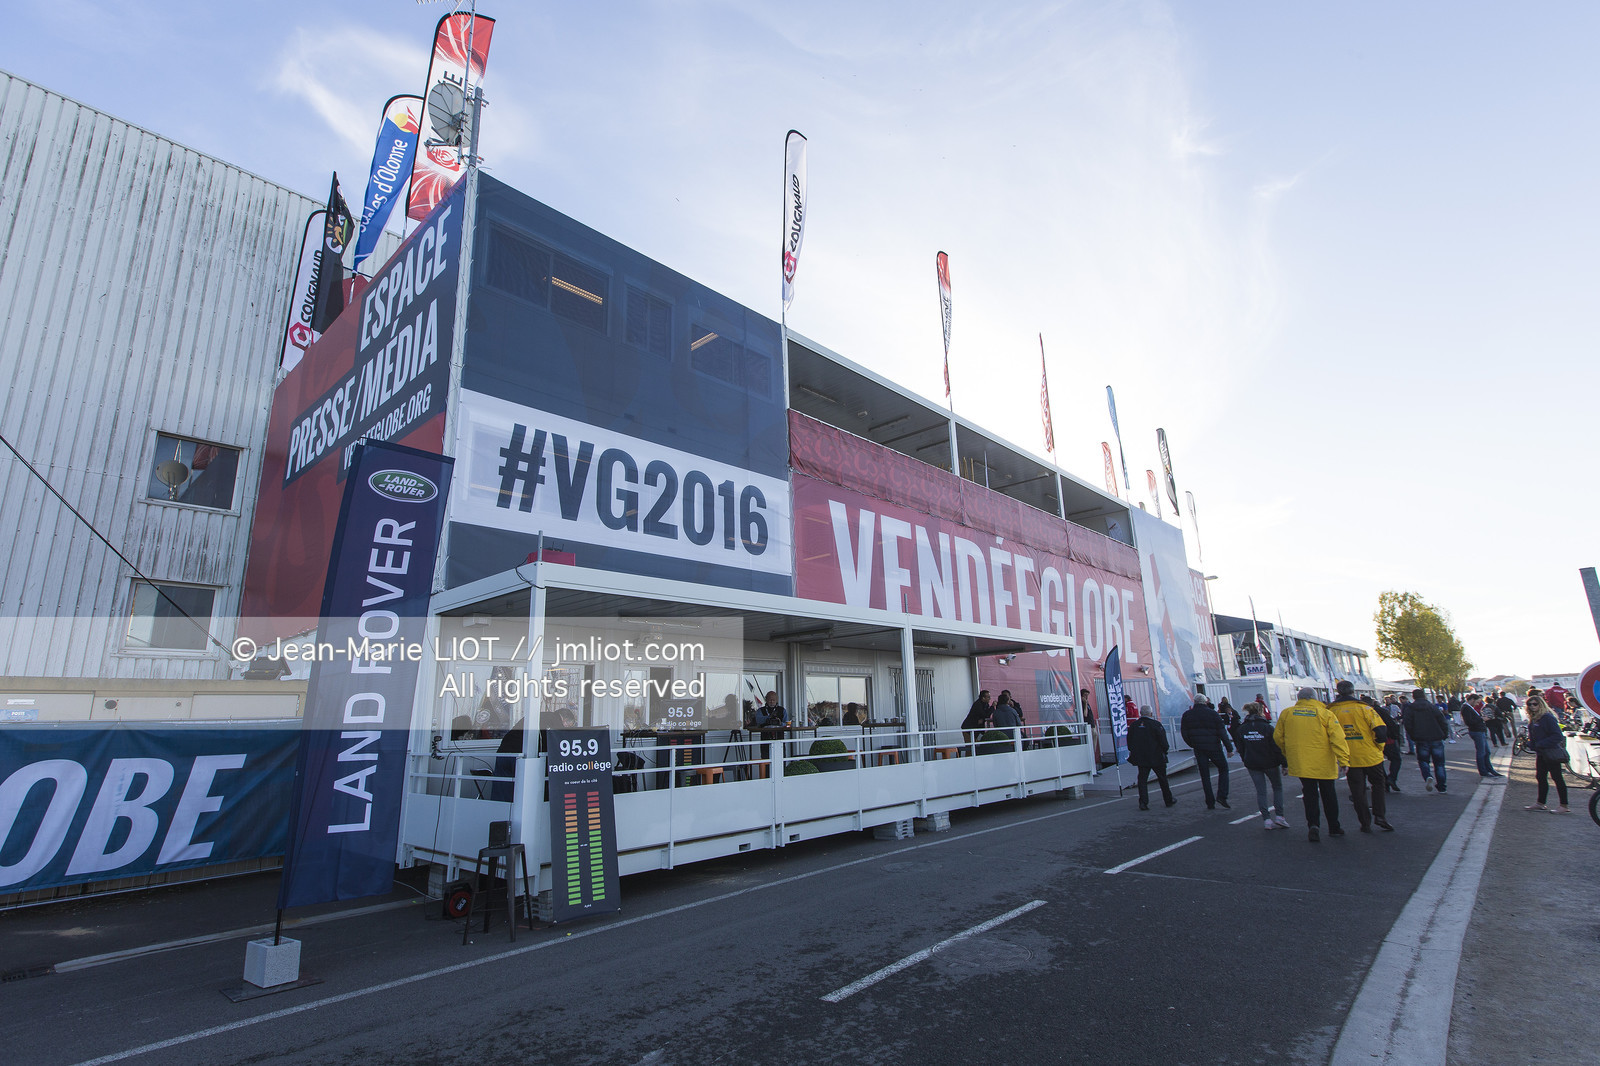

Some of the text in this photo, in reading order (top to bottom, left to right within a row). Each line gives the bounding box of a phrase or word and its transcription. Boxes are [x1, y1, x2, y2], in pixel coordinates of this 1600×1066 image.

[373, 138, 408, 194] d'Olonne
[790, 173, 803, 253] COUGNAUD
[360, 205, 452, 353] ESPACE
[286, 297, 438, 481] PRESSE/MÉDIA
[384, 474, 418, 487] LAND
[384, 484, 426, 498] ROVER
[497, 423, 769, 557] #VG2016
[668, 706, 694, 718] 95.9
[327, 692, 387, 834] LAND
[549, 760, 612, 773] radio collège
[559, 738, 599, 757] 95.9
[0, 753, 248, 887] OBE
